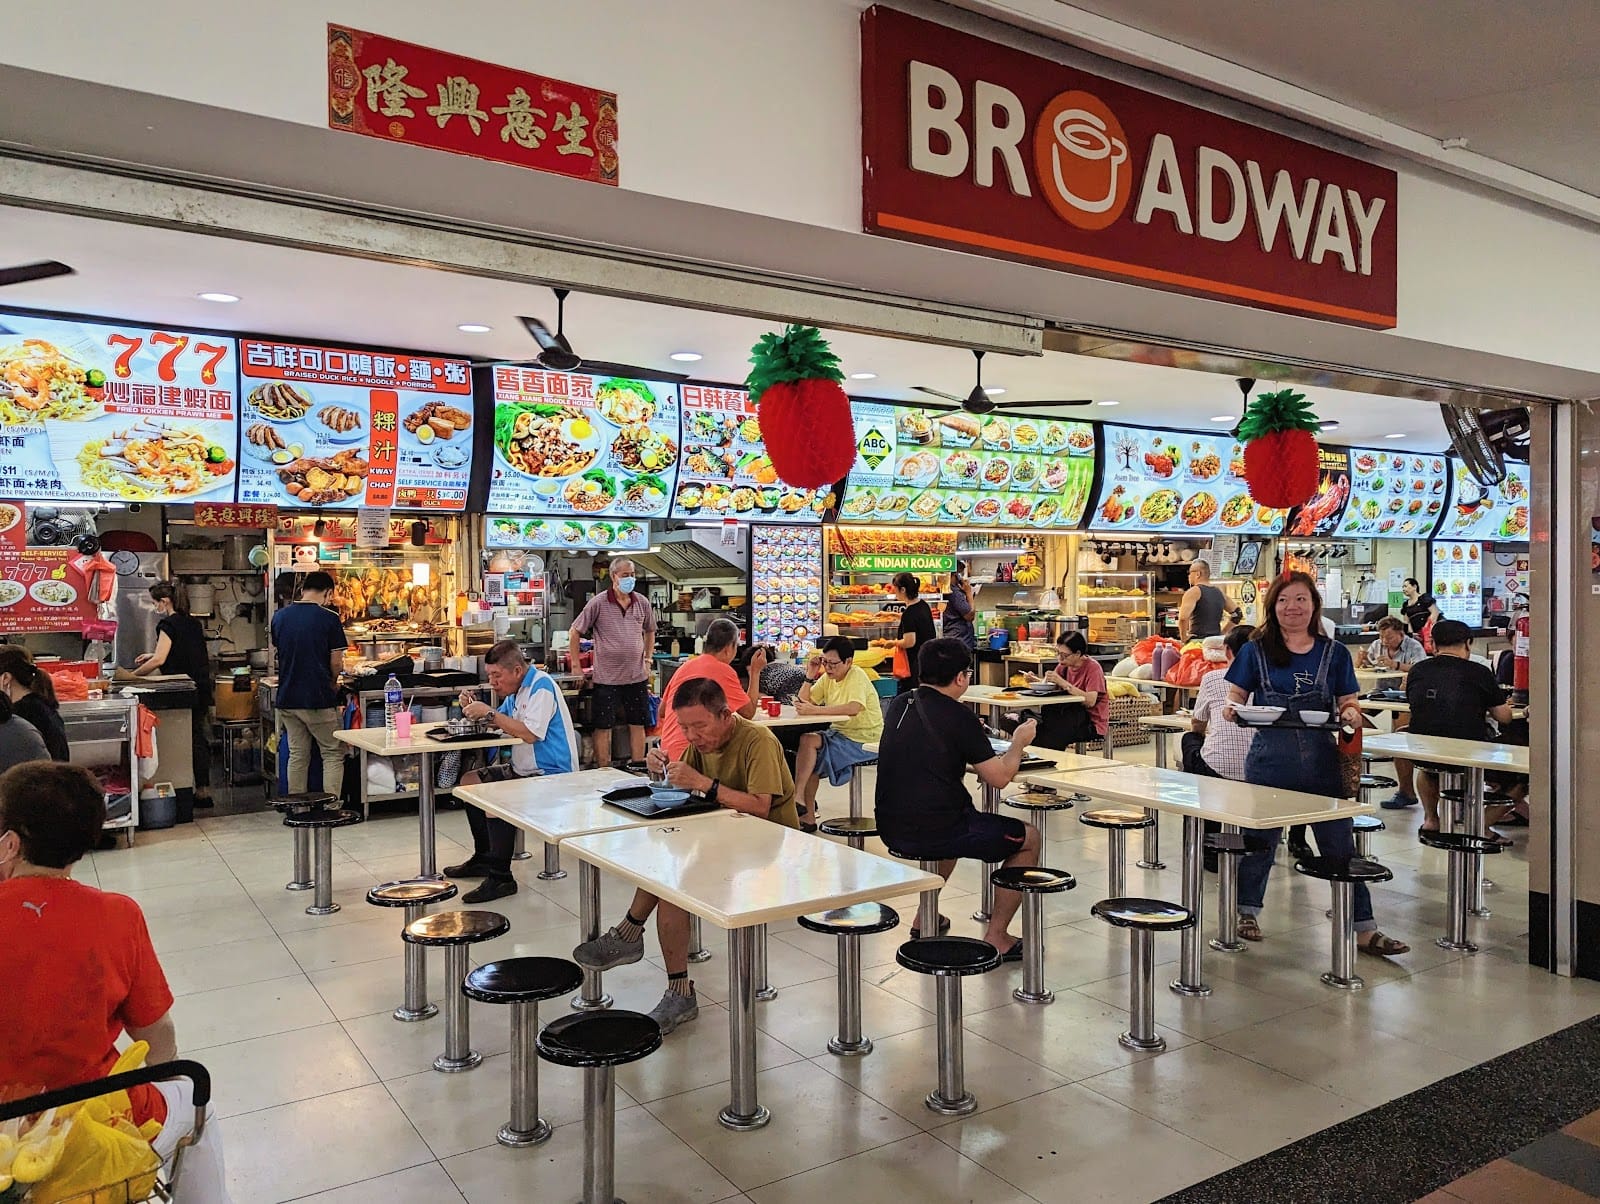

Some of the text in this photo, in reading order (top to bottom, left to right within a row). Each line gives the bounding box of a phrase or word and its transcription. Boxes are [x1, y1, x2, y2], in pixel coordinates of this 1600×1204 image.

[908, 60, 1387, 277] BROADWAY
[284, 371, 318, 379] BRAISED
[365, 377, 395, 386] NOODLE
[401, 381, 437, 389] PORRIDGE
[496, 368, 594, 398] 香香面家
[544, 397, 571, 405] NOODLE
[140, 407, 174, 416] HOKKIEN
[175, 409, 205, 418] PRAWN
[863, 438, 886, 448] ABC
[874, 558, 909, 568] INDIAN
[910, 558, 942, 569] ROJAK
[5, 562, 48, 581] 777
